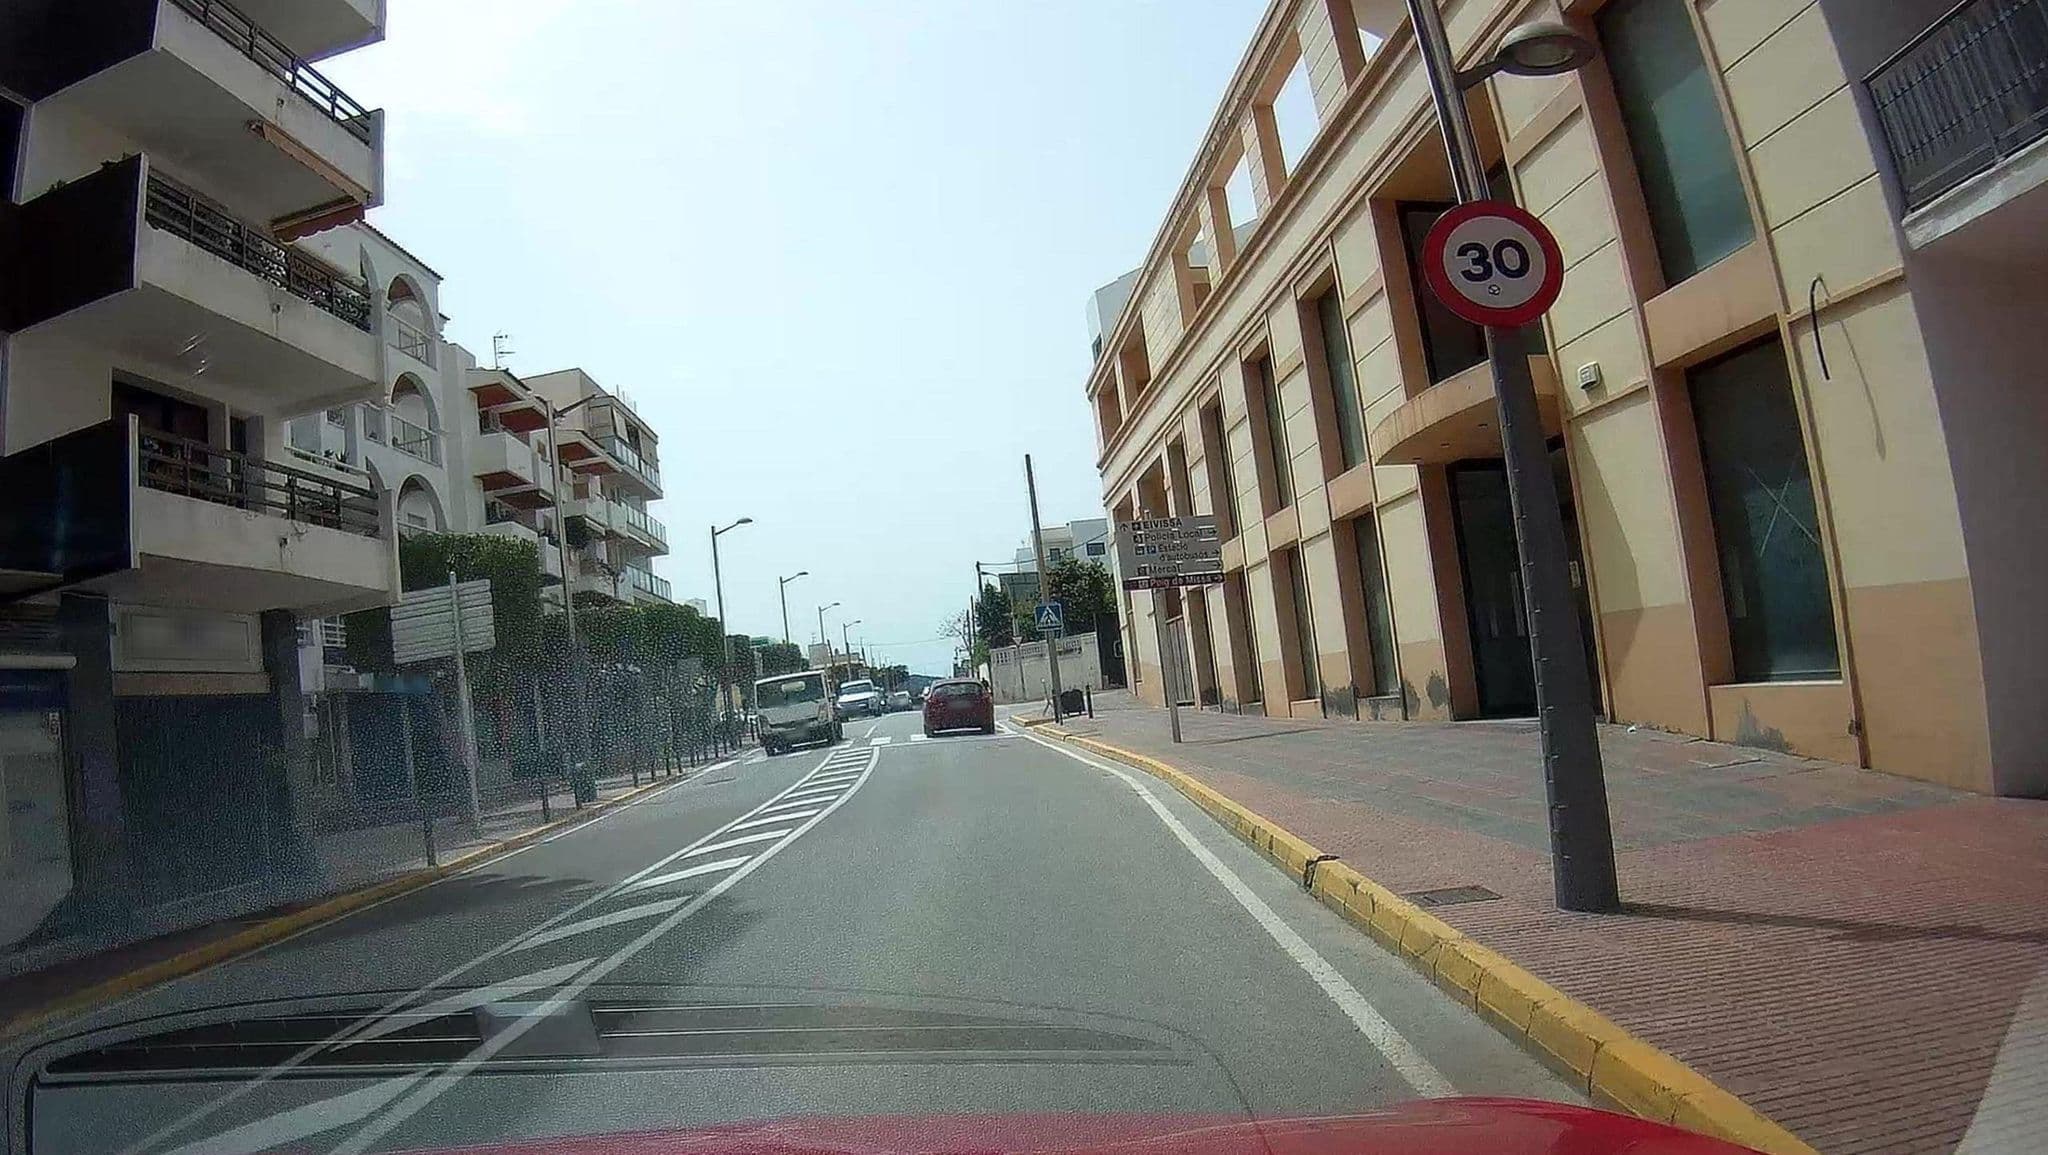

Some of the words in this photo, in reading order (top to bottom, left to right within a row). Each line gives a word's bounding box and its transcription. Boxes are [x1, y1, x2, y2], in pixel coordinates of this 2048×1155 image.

[1457, 238, 1530, 282] 30
[1143, 518, 1182, 529] EIVISSA
[1178, 529, 1203, 539] Local
